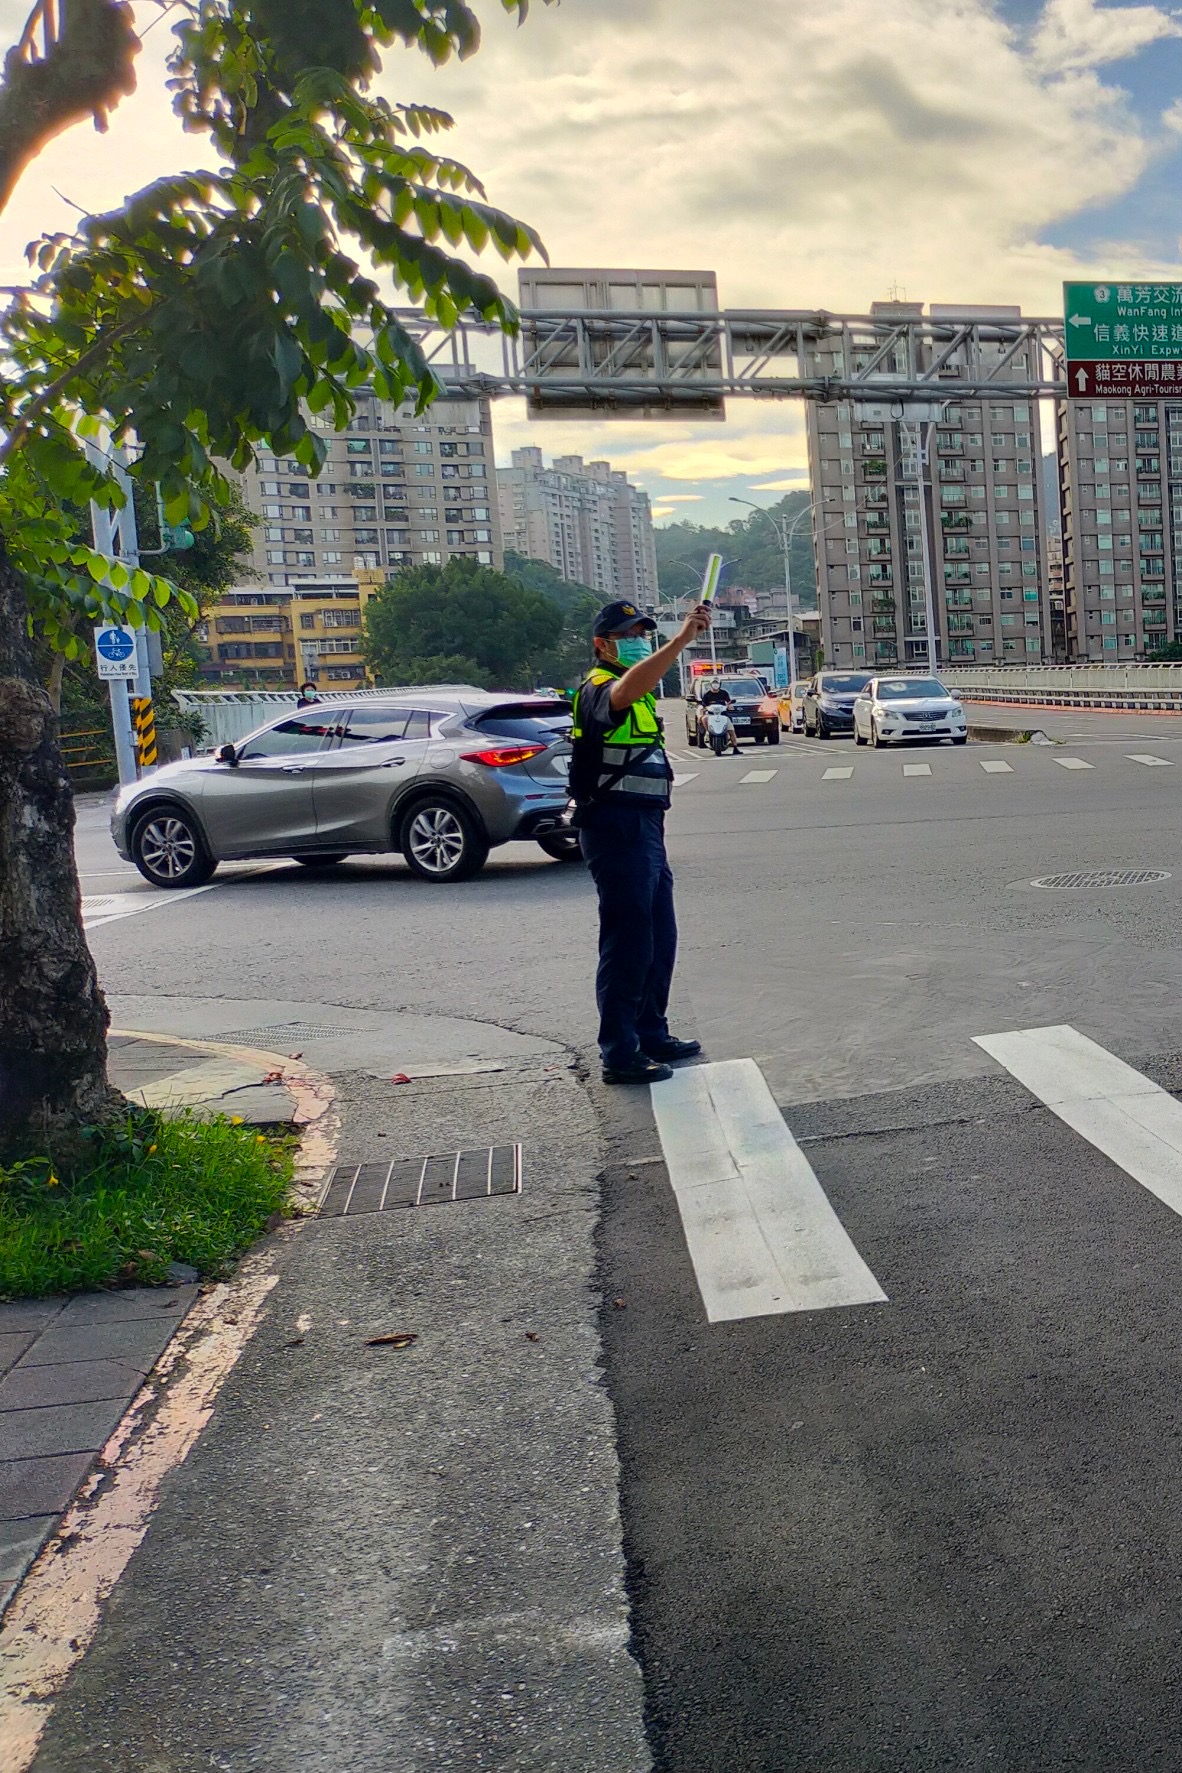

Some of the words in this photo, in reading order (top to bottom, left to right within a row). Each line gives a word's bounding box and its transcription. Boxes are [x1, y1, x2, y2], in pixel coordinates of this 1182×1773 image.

[1100, 290, 1105, 299] 3
[1117, 306, 1167, 319] WanFang
[1112, 345, 1144, 355] XinYi
[1095, 384, 1132, 396] Maokong
[100, 664, 137, 672] 行人優先
